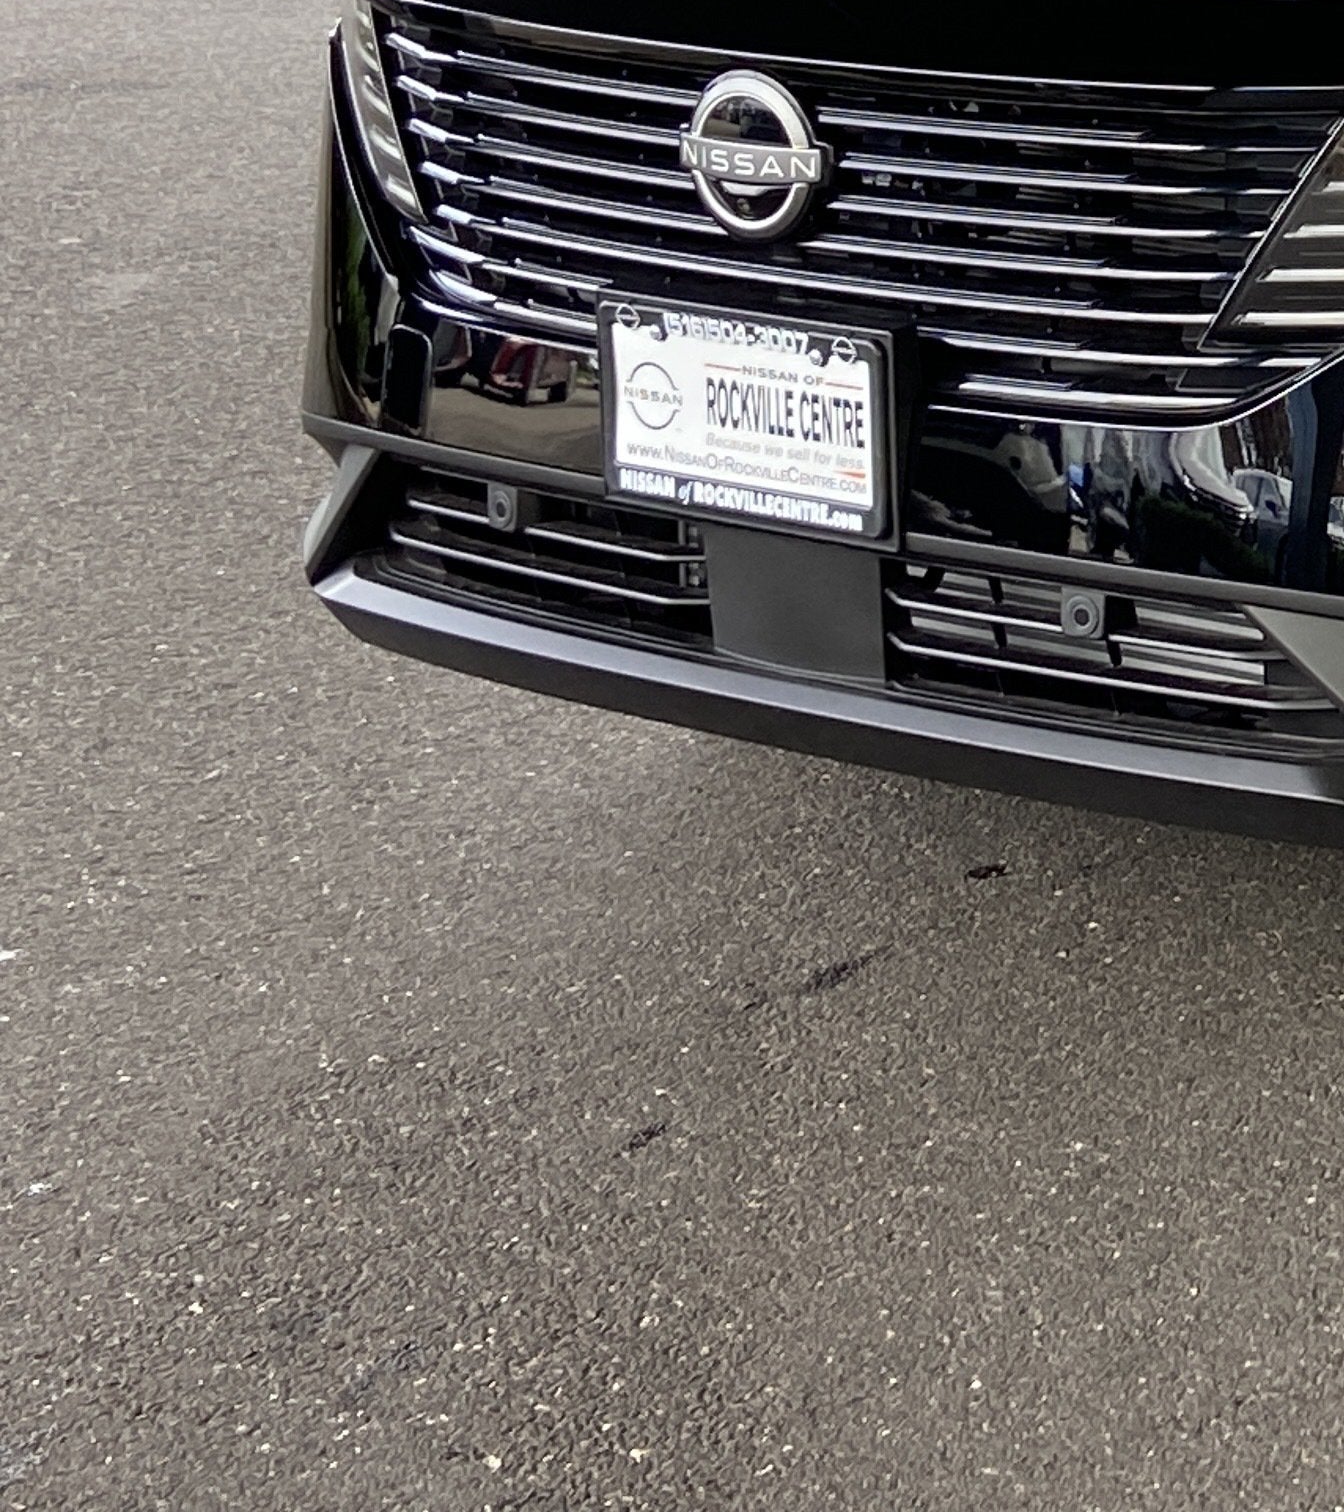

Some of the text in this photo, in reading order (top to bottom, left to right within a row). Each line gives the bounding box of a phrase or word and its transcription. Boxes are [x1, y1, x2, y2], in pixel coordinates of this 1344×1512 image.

[681, 139, 817, 179] NISSAN
[741, 364, 824, 386] NISSAN OF
[623, 385, 684, 407] NISSAN
[706, 376, 866, 450] ROCKVILLE CENTRE
[705, 431, 761, 454] Because
[764, 444, 784, 458] we
[787, 447, 810, 461] sell
[814, 450, 832, 465] for
[619, 468, 675, 499] NISSAN
[678, 481, 693, 505] of
